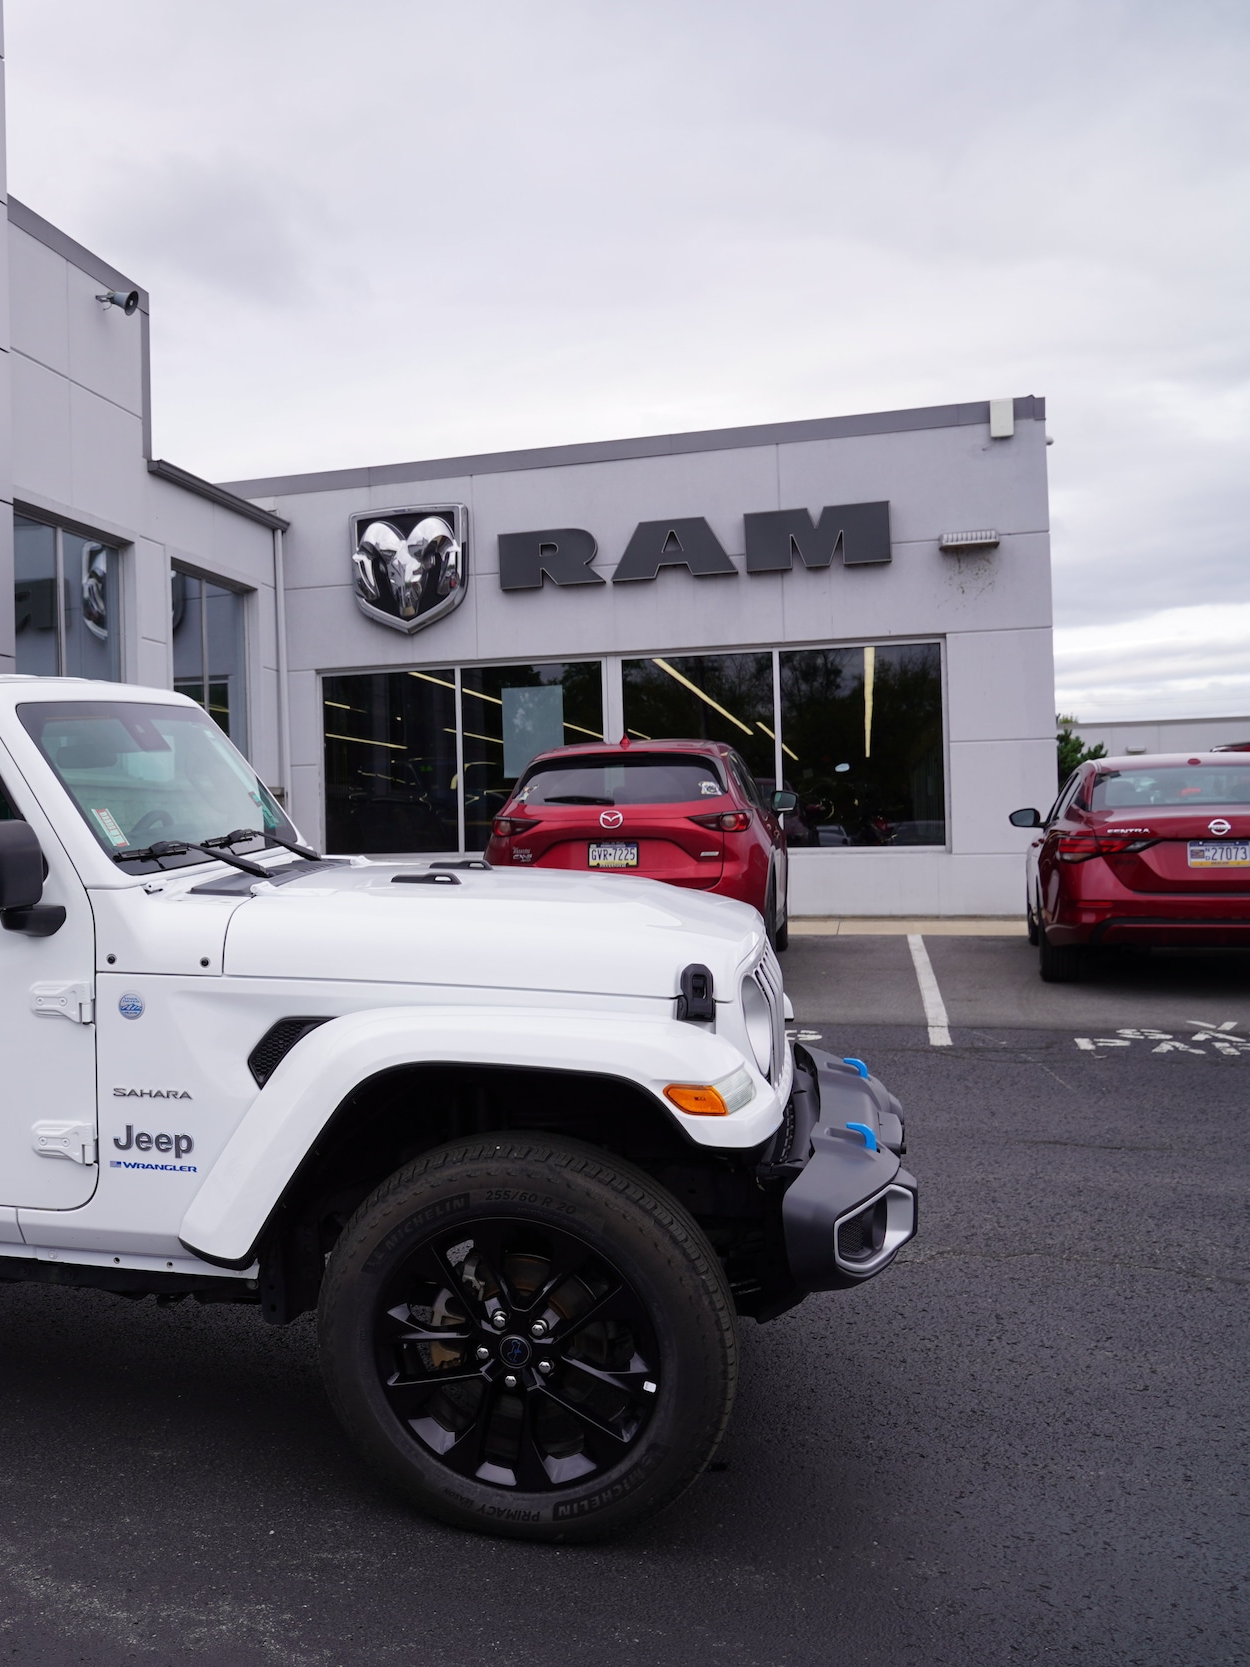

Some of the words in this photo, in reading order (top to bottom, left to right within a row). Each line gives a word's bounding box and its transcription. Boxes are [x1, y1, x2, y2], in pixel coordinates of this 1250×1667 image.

[497, 500, 892, 591] RAM
[113, 1087, 193, 1100] SAHARA
[113, 1122, 194, 1159] Jeep
[123, 1161, 198, 1173] WRANGLER
[385, 1197, 466, 1250] MICHELIN
[485, 1189, 538, 1204] 255/60
[558, 1203, 577, 1215] 20
[558, 1467, 643, 1518] MICHELIN
[476, 1504, 540, 1522] PRIMACY
